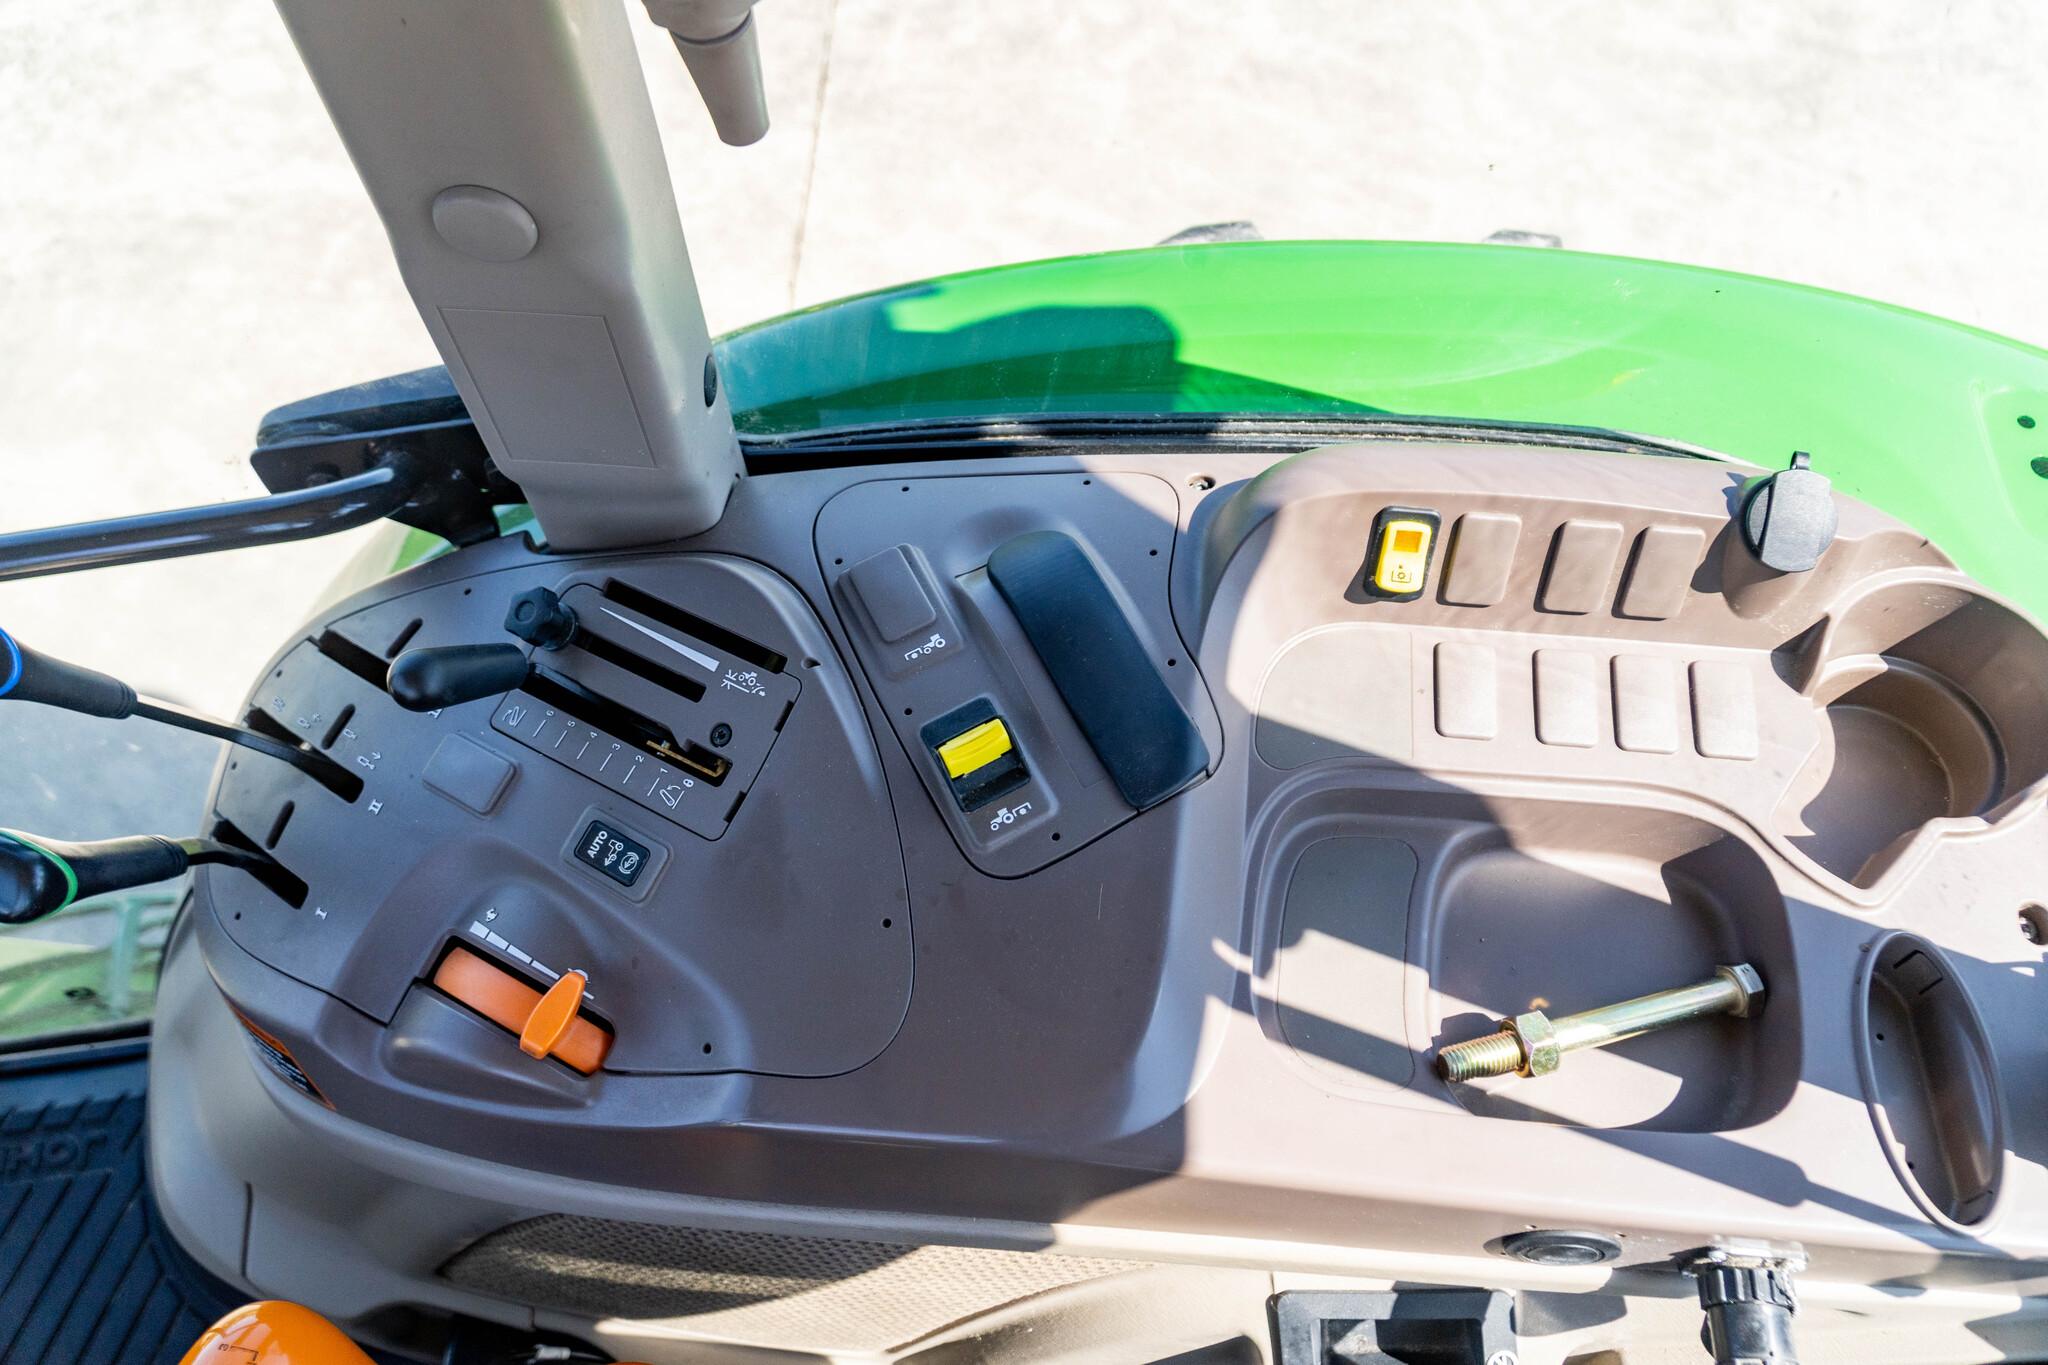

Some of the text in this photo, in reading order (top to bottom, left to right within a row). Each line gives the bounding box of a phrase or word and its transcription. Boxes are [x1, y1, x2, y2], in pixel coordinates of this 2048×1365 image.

[567, 720, 576, 728] 5
[590, 731, 598, 739] 4
[612, 743, 621, 751] 3
[635, 755, 644, 763] 2
[587, 830, 608, 859] AUTO
